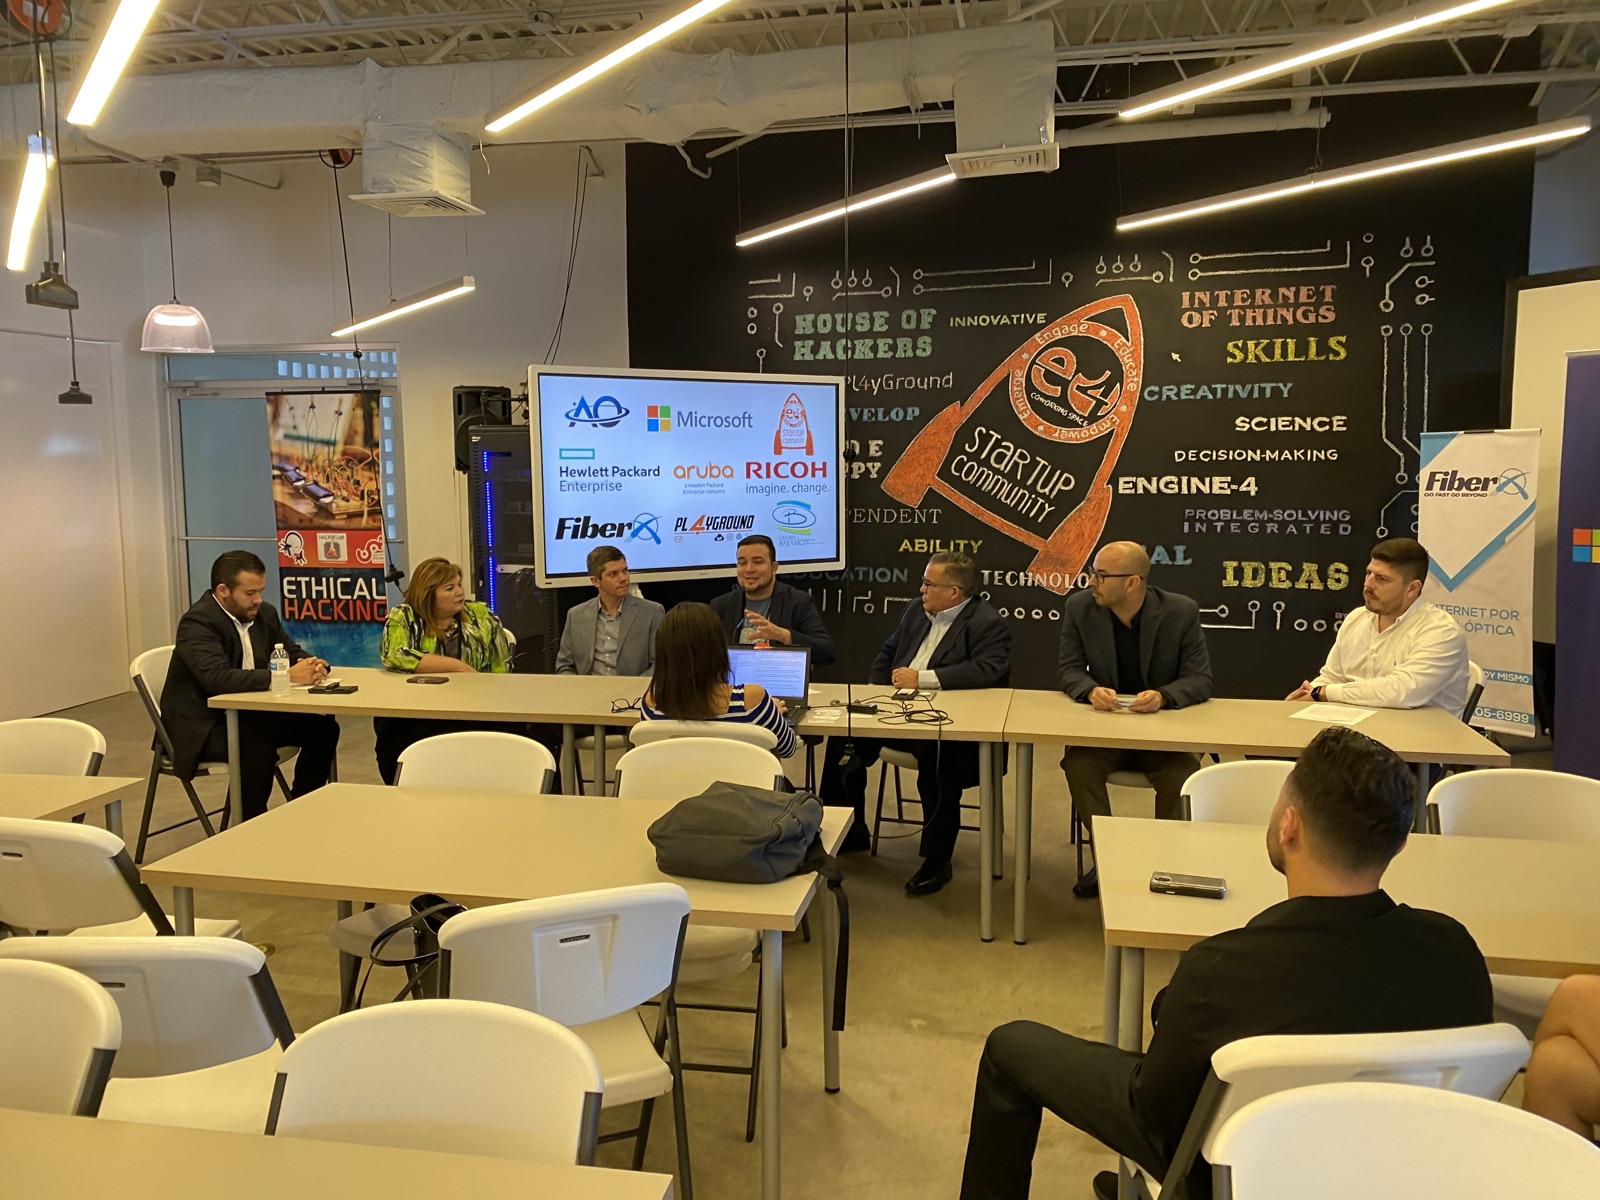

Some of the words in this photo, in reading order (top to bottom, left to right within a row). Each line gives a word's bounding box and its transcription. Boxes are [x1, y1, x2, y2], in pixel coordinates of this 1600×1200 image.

[1181, 285, 1337, 309] INTERNET
[794, 311, 890, 334] HOUSE
[901, 309, 937, 330] OF
[950, 313, 1047, 328] INNOVATIVE
[1181, 309, 1218, 328] OF
[1227, 305, 1336, 327] THINGS
[1034, 322, 1089, 344] Engage
[793, 336, 933, 361] HACKERS
[1226, 336, 1348, 364] SKILLS
[1113, 337, 1140, 392] Educate
[1012, 369, 1030, 420] Emerge
[1143, 383, 1293, 402] CREATIVITY
[1030, 392, 1068, 417] COWORKING
[1067, 412, 1089, 427] SPACE
[677, 411, 753, 428] Microsoft
[1052, 414, 1120, 440] Empower
[1235, 415, 1347, 432] SCIENCE
[1174, 449, 1338, 463] DECISION-MAKING
[559, 466, 609, 478] Hewlett
[612, 466, 660, 477] Packard
[673, 462, 734, 479] aruba
[745, 461, 827, 479] RICOH
[559, 480, 622, 494] Enterprise
[745, 483, 789, 496] imagine.
[791, 482, 830, 495] change.
[1118, 476, 1258, 496] ENGINE-4
[674, 515, 755, 534] PL4YGROUND
[1184, 509, 1351, 522] PROBLEM-SOLVING
[1183, 522, 1352, 536] INTEGRATED
[898, 539, 983, 554] ABILITY
[1222, 560, 1349, 591] IDEAS
[283, 577, 387, 600] ETHICAL
[284, 599, 389, 622] HACKING
[1489, 608, 1519, 620] POR
[1464, 619, 1515, 636] ÓPTICA
[1497, 673, 1530, 684] MISMO
